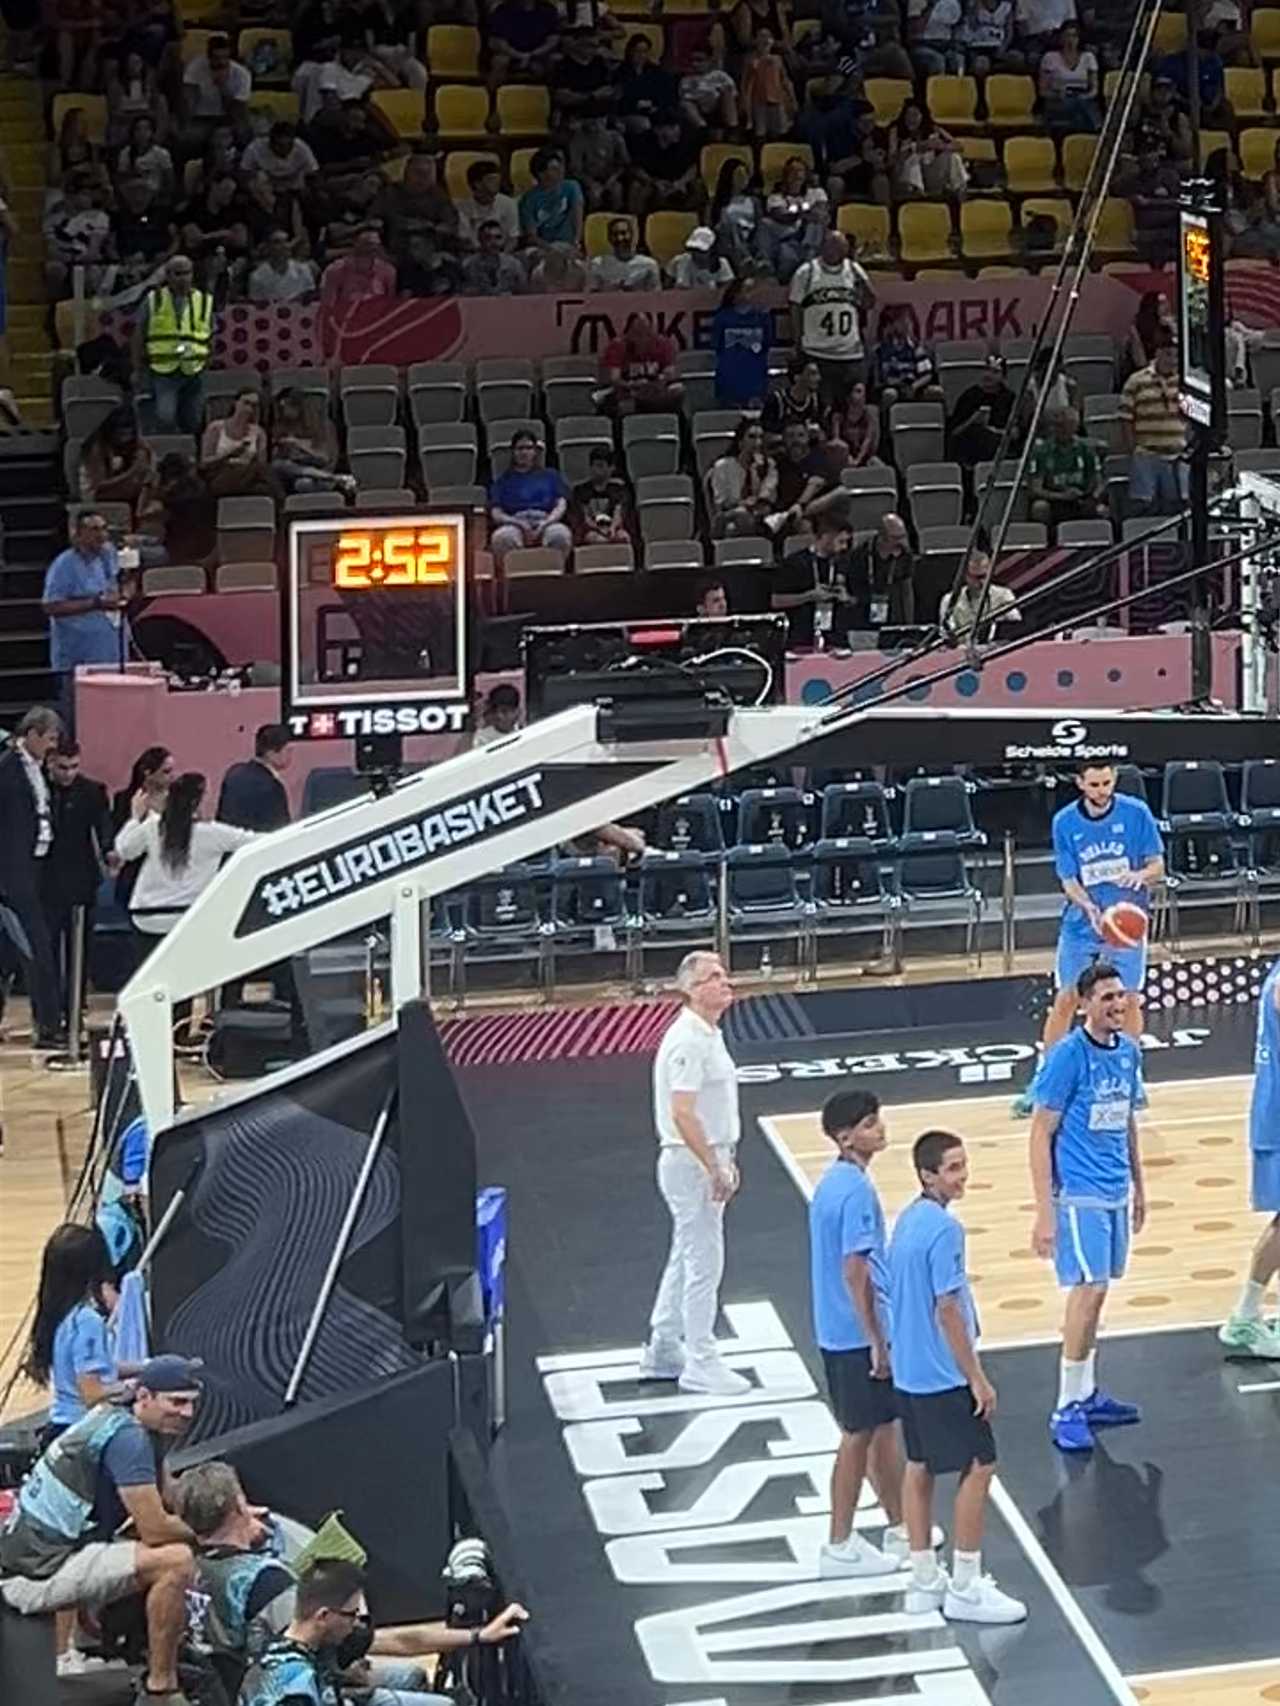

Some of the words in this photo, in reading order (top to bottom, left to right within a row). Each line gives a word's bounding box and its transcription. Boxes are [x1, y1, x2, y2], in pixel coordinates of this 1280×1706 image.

[819, 309, 853, 337] 40
[335, 534, 450, 587] 2:52
[338, 703, 470, 735] TISSOT
[1074, 744, 1128, 760] Sports
[260, 772, 543, 917] #EUROBASKET
